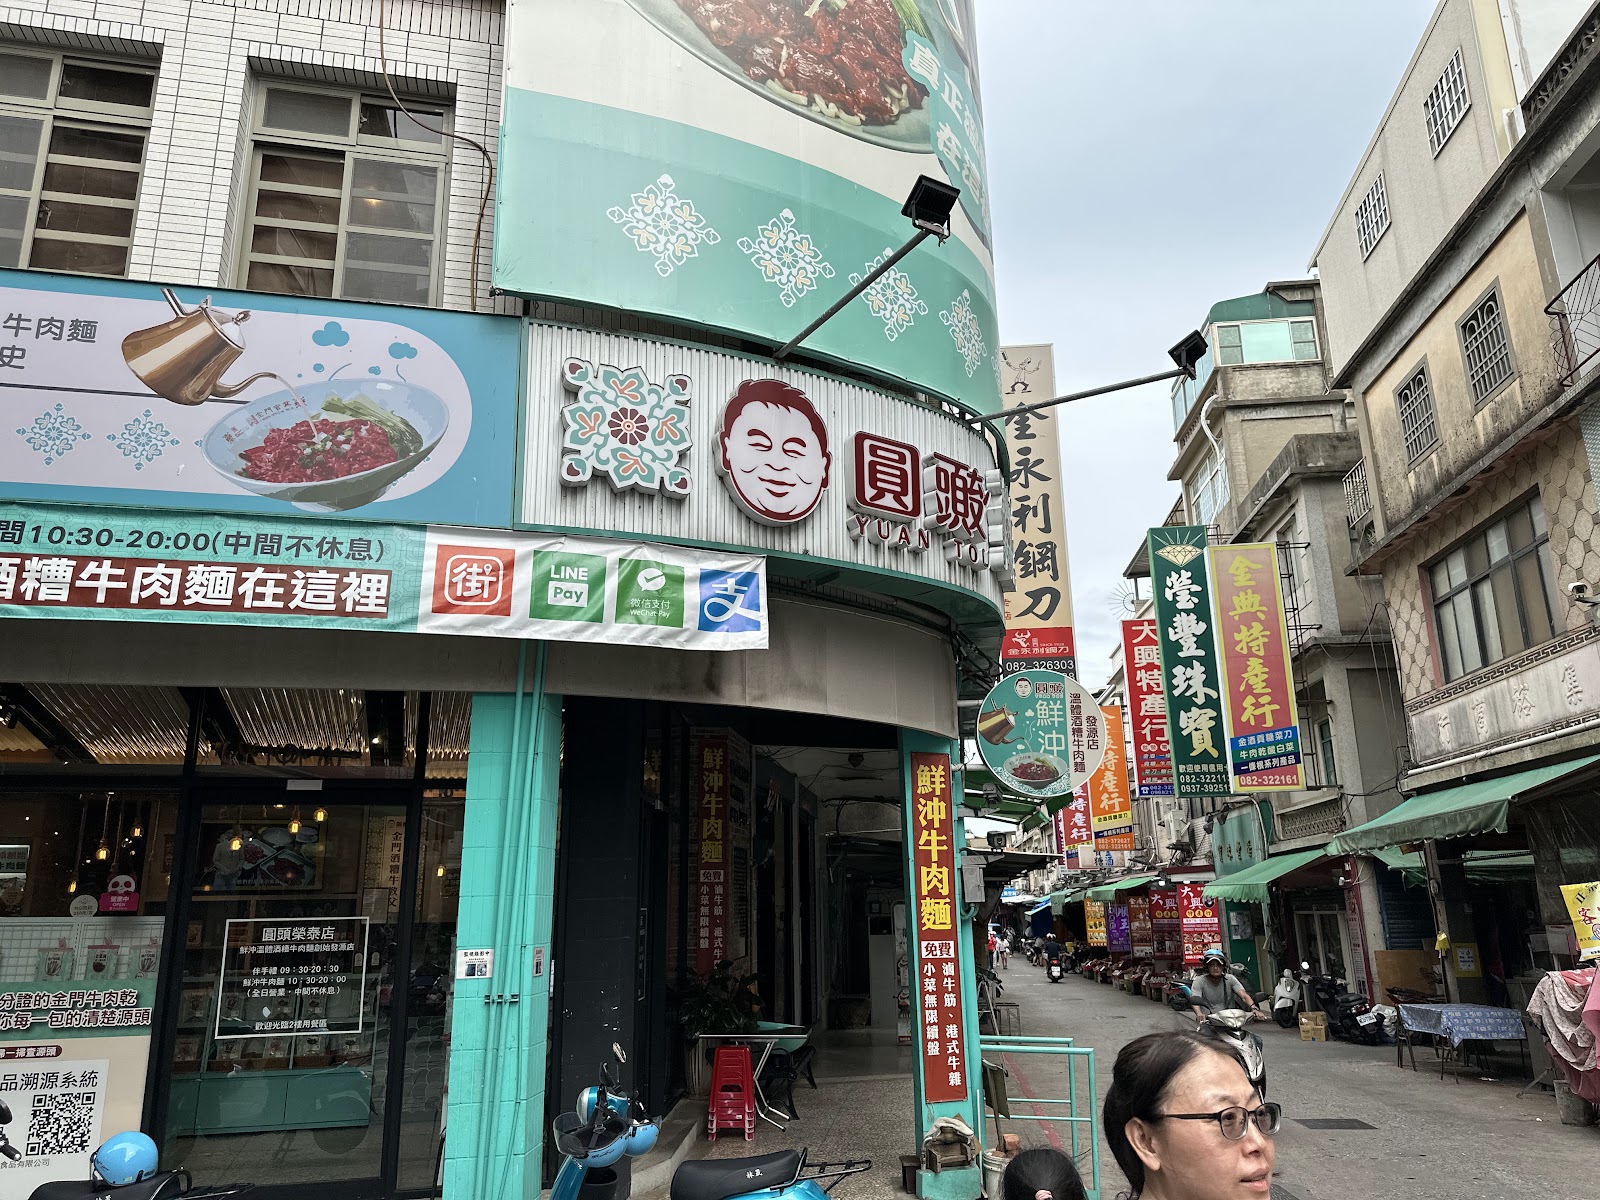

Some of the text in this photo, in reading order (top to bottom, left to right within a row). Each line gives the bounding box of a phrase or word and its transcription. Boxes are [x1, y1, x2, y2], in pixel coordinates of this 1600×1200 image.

[1003, 401, 1062, 621] 金永利鋼刀
[855, 513, 930, 549] YUAN
[550, 565, 589, 581] LINE
[553, 586, 584, 604] Pay
[630, 598, 670, 609] 微信支付
[630, 608, 670, 618] WeChat Pay
[1228, 554, 1281, 728] 金典特產行
[1006, 660, 1074, 672] 082-326303
[1132, 620, 1169, 742] 大興特產行
[1036, 700, 1065, 756] 鮮沖
[1085, 715, 1099, 750] 發源店
[1238, 729, 1292, 747] 金酒貢糖菜刀
[1240, 742, 1294, 760] 牛肉乾酸白菜
[1240, 774, 1297, 785] 082-322161
[702, 748, 723, 863] 鮮沖牛肉麵
[917, 764, 951, 931] 鮮沖牛肉麵
[703, 871, 721, 881] 免費
[261, 926, 335, 941] 圓頭榮泰店
[924, 942, 952, 957] 免費
[252, 966, 277, 975] 伴手禮
[923, 962, 940, 1056] 小菜無限續盤
[1, 1070, 99, 1092] 品溯源系統
